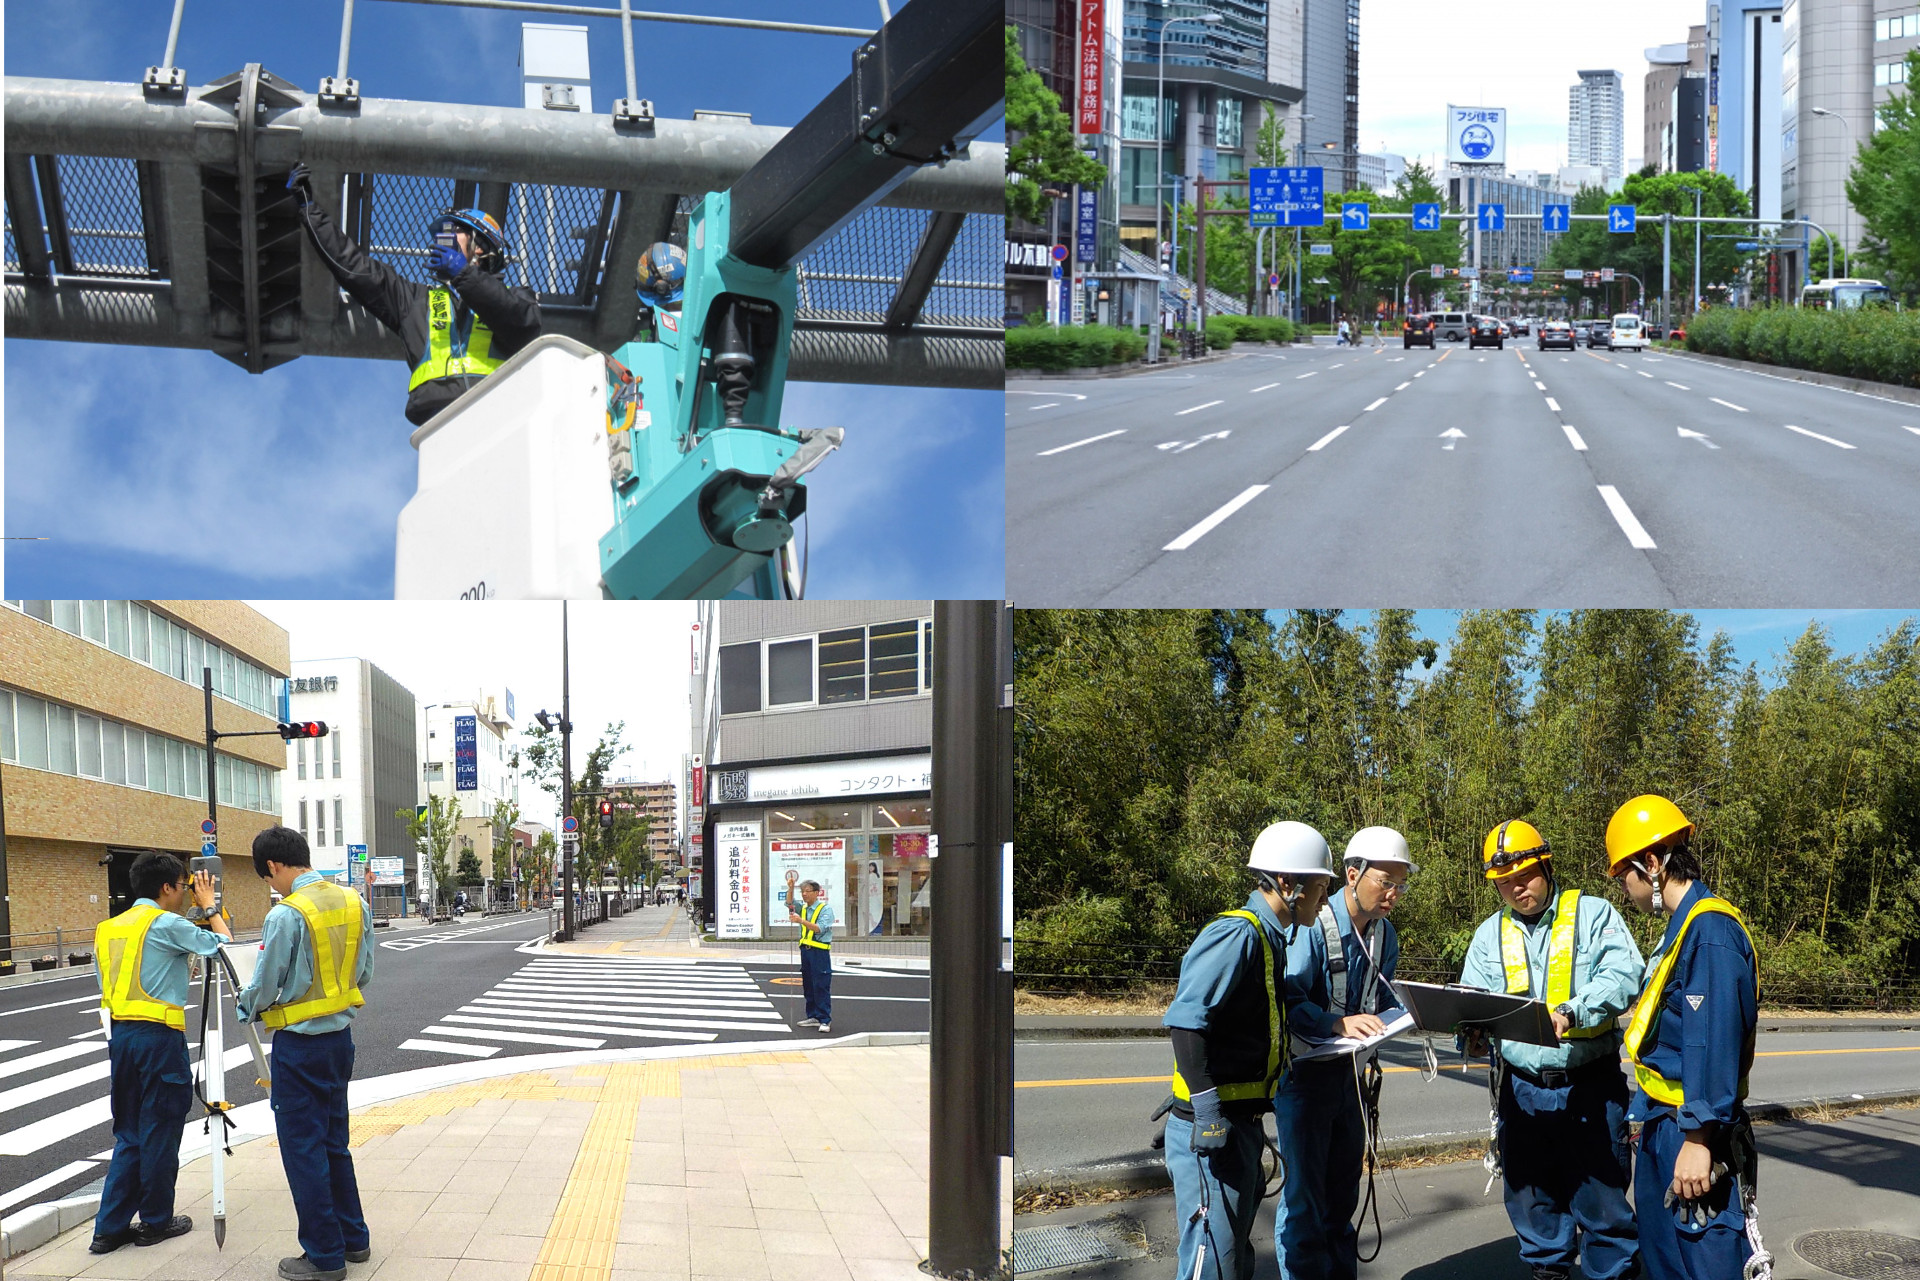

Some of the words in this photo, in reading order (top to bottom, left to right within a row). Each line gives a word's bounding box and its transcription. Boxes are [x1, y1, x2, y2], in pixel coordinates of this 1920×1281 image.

[1082, 3, 1099, 126] アトム法律事務所
[1457, 111, 1499, 123] フジ住宅
[753, 788, 788, 799] megane
[791, 786, 820, 796] ichiba
[741, 845, 750, 914] どんな度数でも
